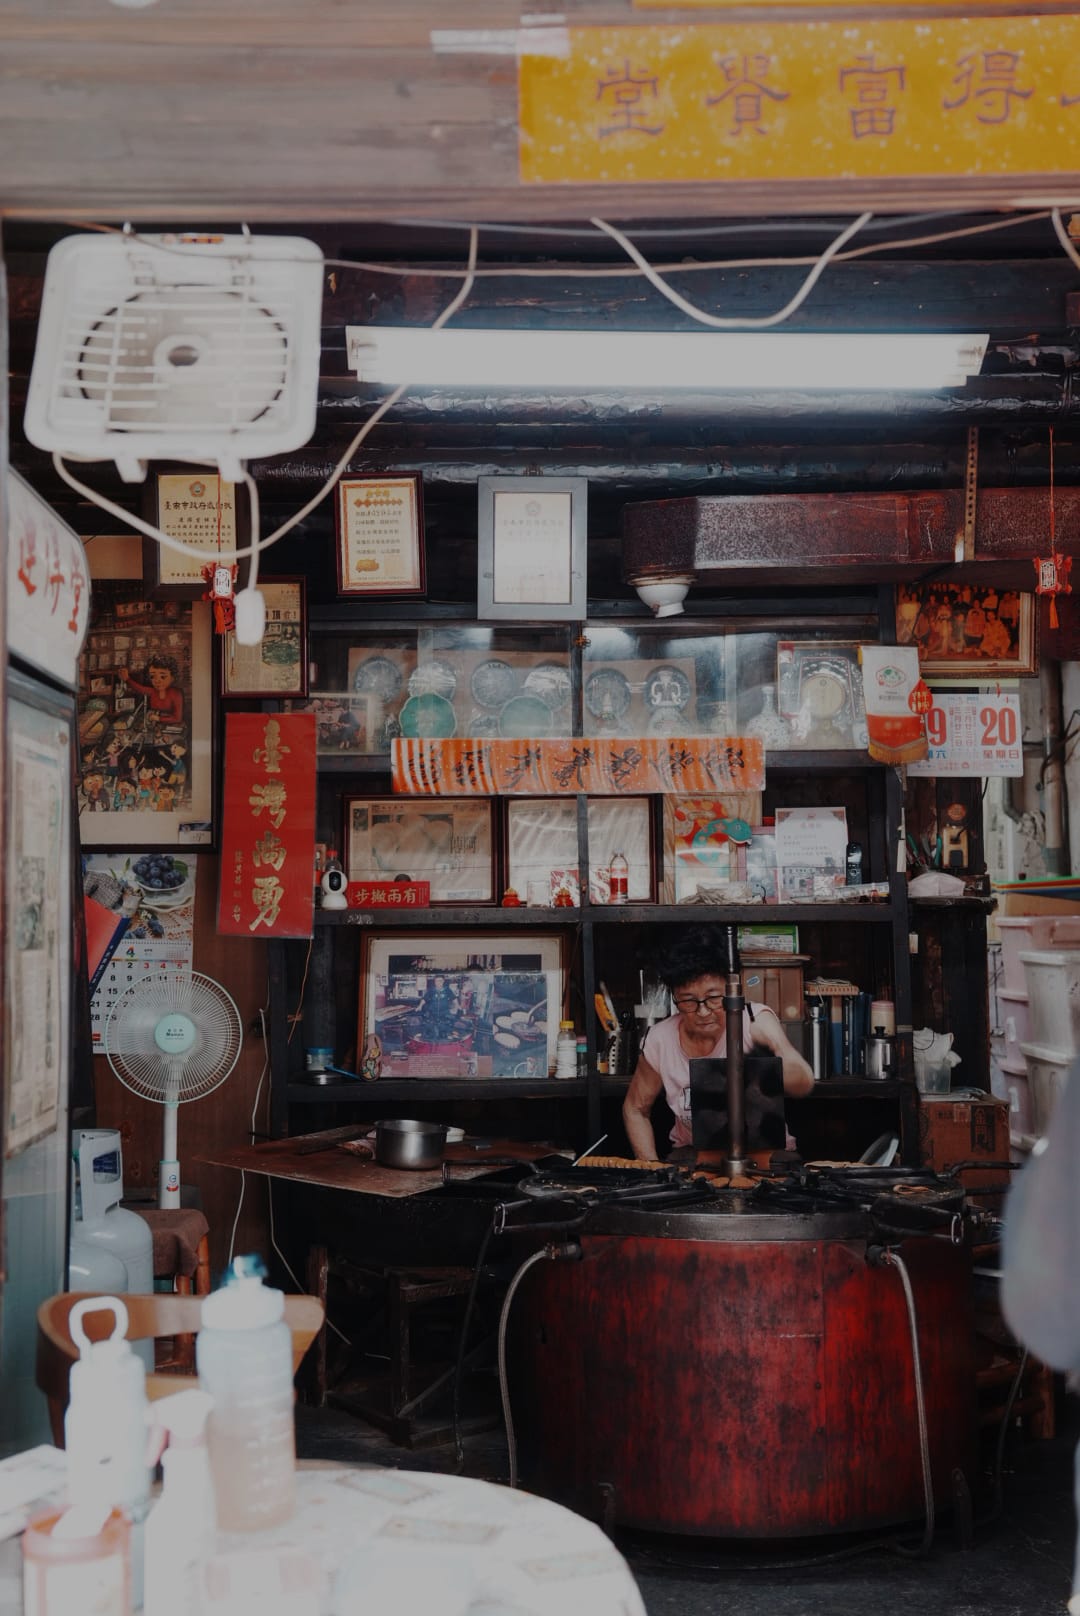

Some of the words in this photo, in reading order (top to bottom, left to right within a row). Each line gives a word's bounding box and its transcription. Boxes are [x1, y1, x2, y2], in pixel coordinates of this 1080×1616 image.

[980, 707, 1017, 746] 20
[983, 749, 1020, 759] 星期日
[248, 718, 292, 932] 臺灣尚勇
[126, 945, 135, 957] 4
